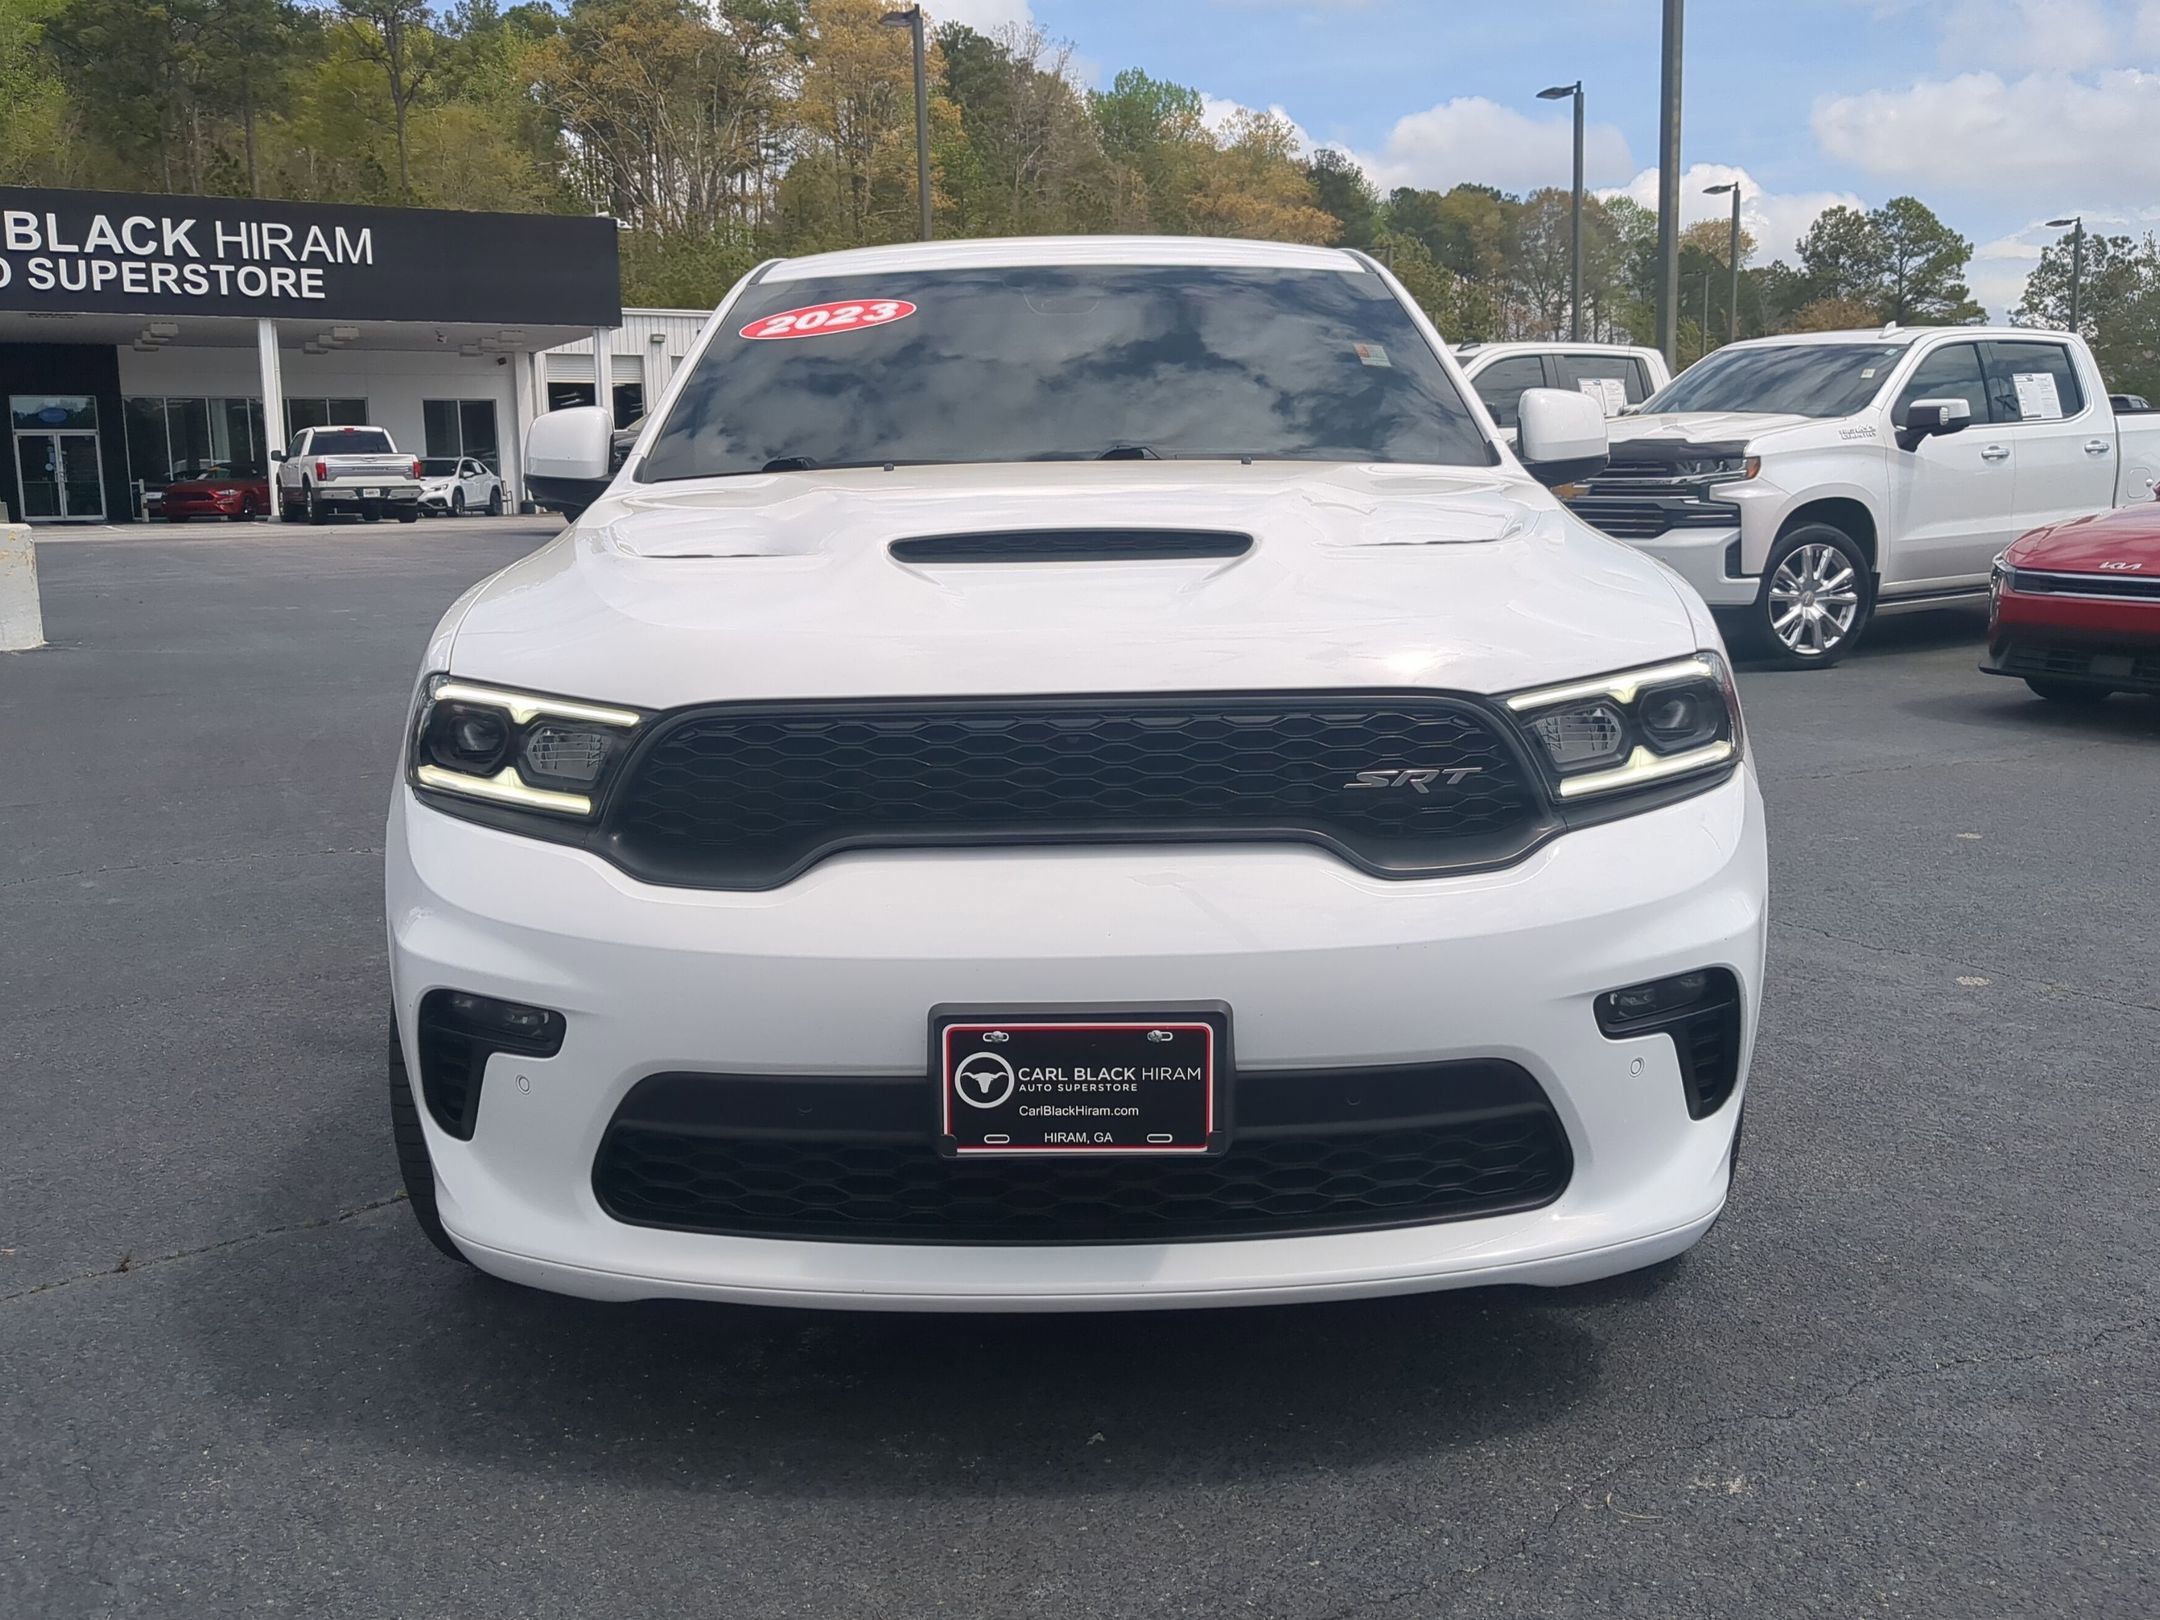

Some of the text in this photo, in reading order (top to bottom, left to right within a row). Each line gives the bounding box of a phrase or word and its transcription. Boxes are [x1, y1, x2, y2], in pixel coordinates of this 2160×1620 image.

[3, 210, 373, 265] BLACK HIRAM
[27, 257, 326, 299] SUPERSTORE
[756, 302, 899, 336] 2023
[1343, 767, 1483, 794] SRT
[1018, 1067, 1201, 1081] CARL BLACK HIRAM
[1019, 1083, 1138, 1092] AUTO SUPERSTORE
[1019, 1105, 1139, 1117] CarlBlackHiram.com
[1044, 1132, 1113, 1144] HIRAM, GA
